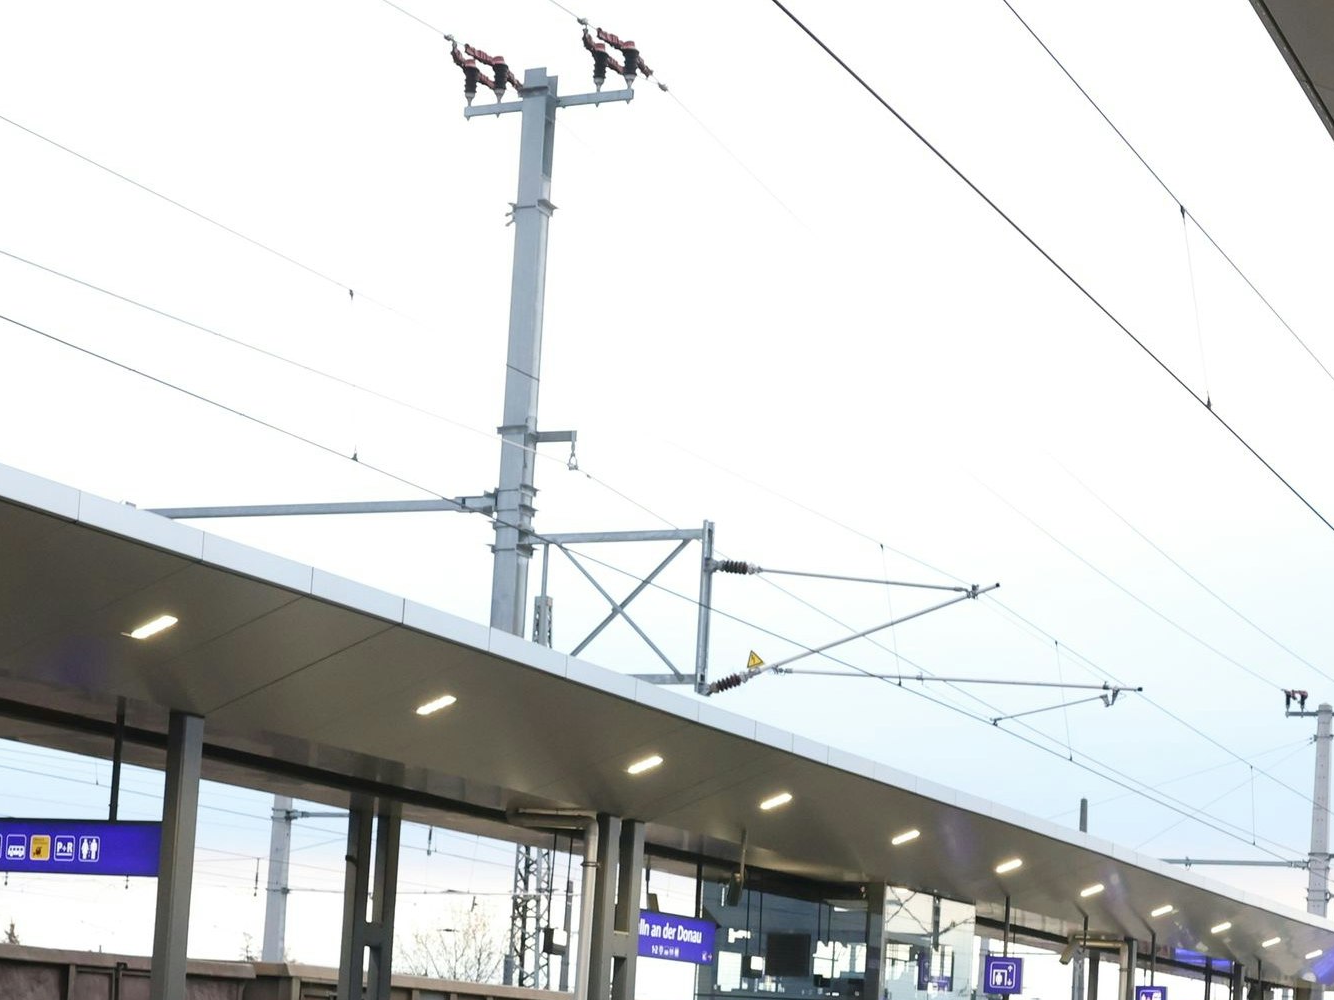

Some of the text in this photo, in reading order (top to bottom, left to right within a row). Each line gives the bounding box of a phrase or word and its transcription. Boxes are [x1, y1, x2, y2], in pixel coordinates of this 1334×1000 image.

[639, 918, 702, 944] lln an der Donau
